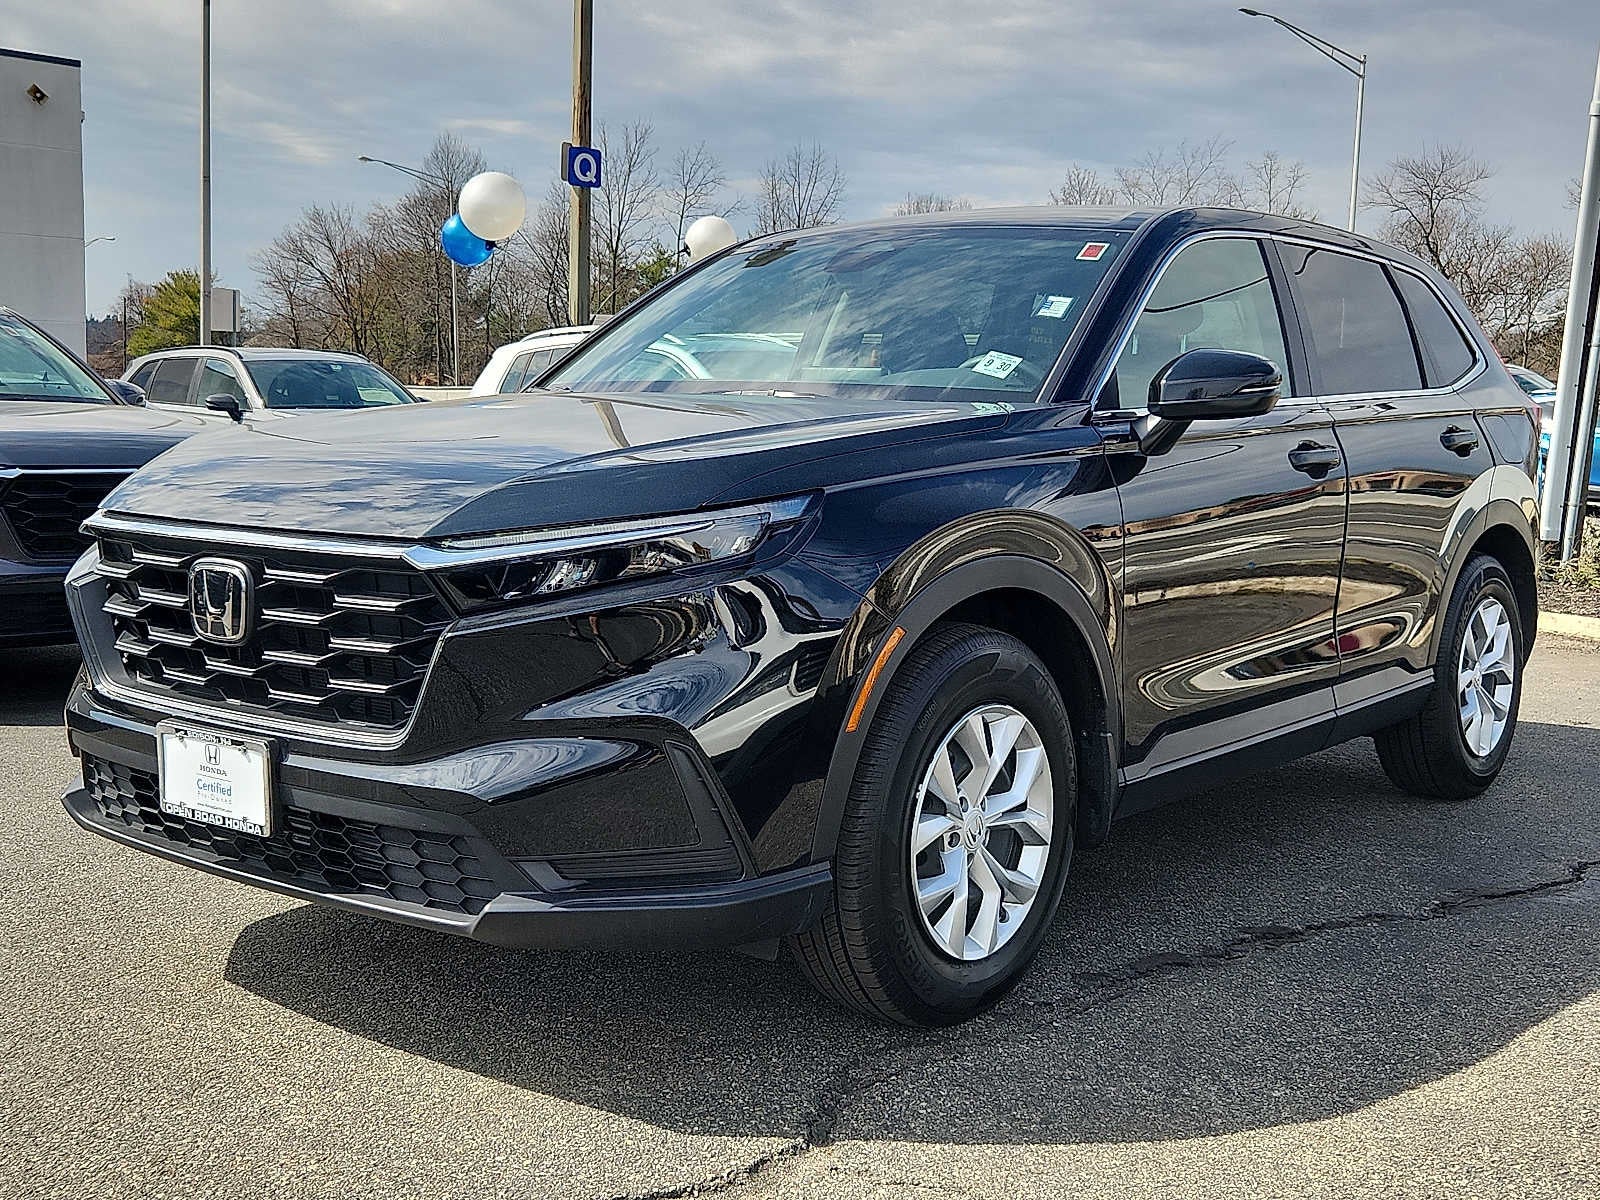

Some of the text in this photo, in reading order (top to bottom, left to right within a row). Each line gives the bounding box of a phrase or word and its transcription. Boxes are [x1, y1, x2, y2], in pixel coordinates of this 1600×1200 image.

[574, 153, 597, 183] Q
[984, 359, 994, 367] 9
[996, 362, 1011, 371] 30
[199, 764, 227, 776] HONDA
[197, 778, 232, 797] Certified
[165, 803, 193, 818] OPEN
[194, 809, 224, 825] ROAD
[225, 817, 262, 836] HONDA
